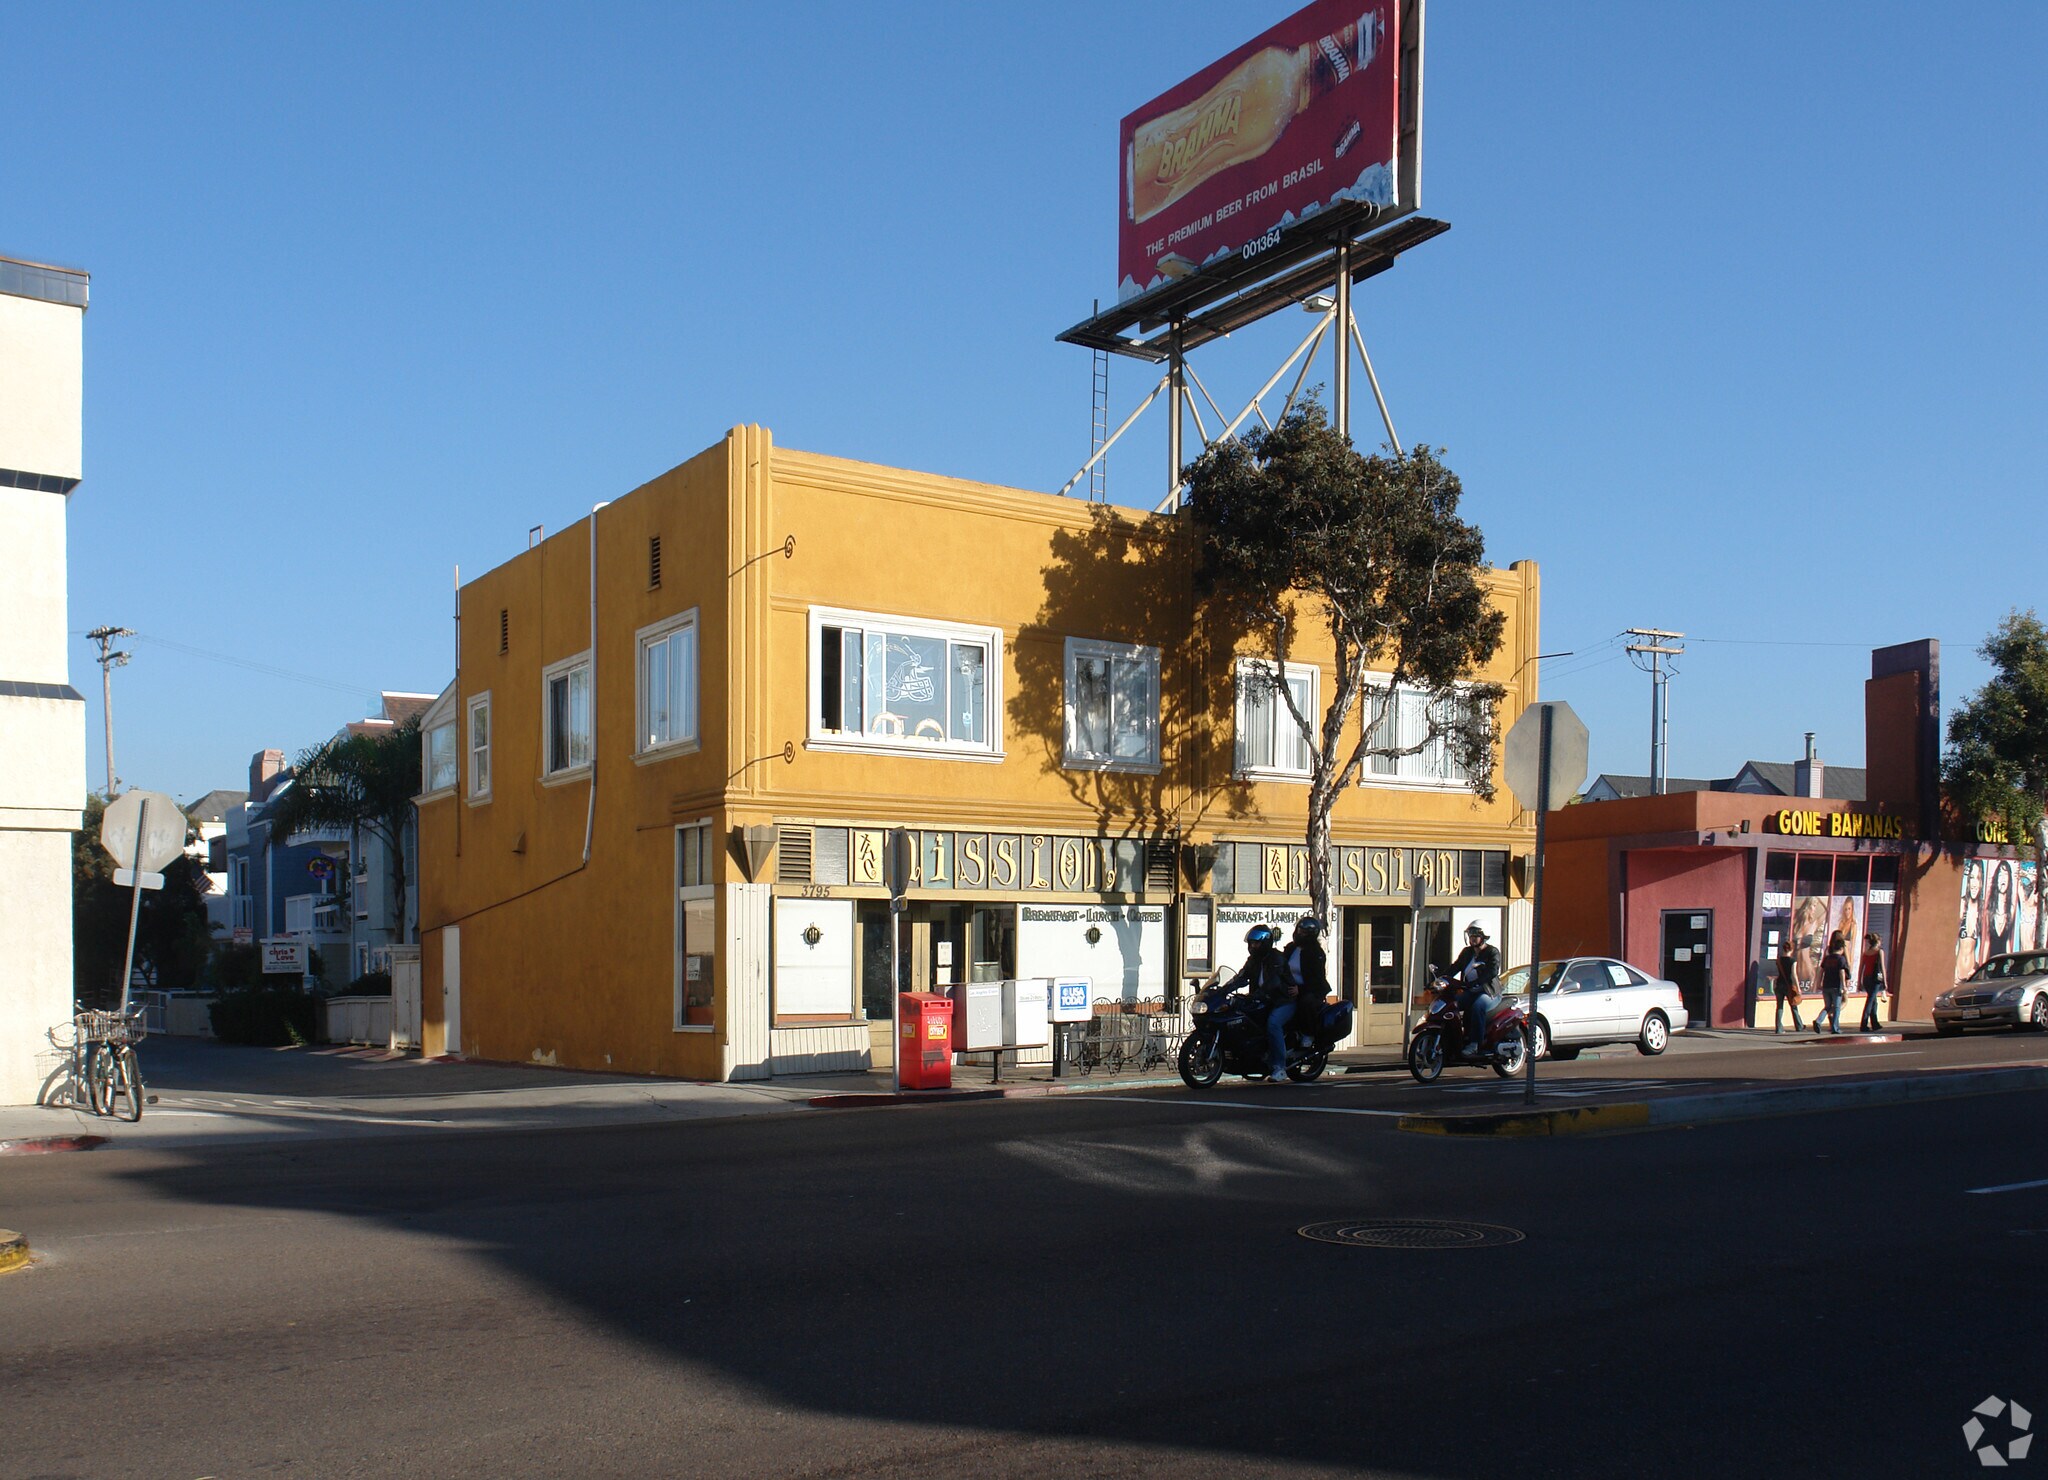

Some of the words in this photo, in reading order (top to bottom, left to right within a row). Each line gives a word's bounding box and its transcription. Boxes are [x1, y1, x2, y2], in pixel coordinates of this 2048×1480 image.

[1319, 34, 1351, 84] BRAHMA
[1157, 95, 1241, 178] BRAHMA
[1335, 121, 1361, 159] BRAHMA
[1145, 238, 1165, 257] THE
[1168, 213, 1213, 247] PREMIUM
[1216, 199, 1243, 223] BEER
[1246, 180, 1278, 208] FROM
[1282, 158, 1325, 189] BRASIL
[1242, 229, 1281, 260] 001364
[1779, 809, 1822, 836] GONE
[1831, 812, 1902, 840] BANANAS
[801, 886, 831, 898] 3795
[1763, 893, 1791, 906] SALE
[1870, 890, 1896, 903] SALE
[1062, 995, 1086, 1006] TODAY
[1069, 986, 1085, 997] USA
